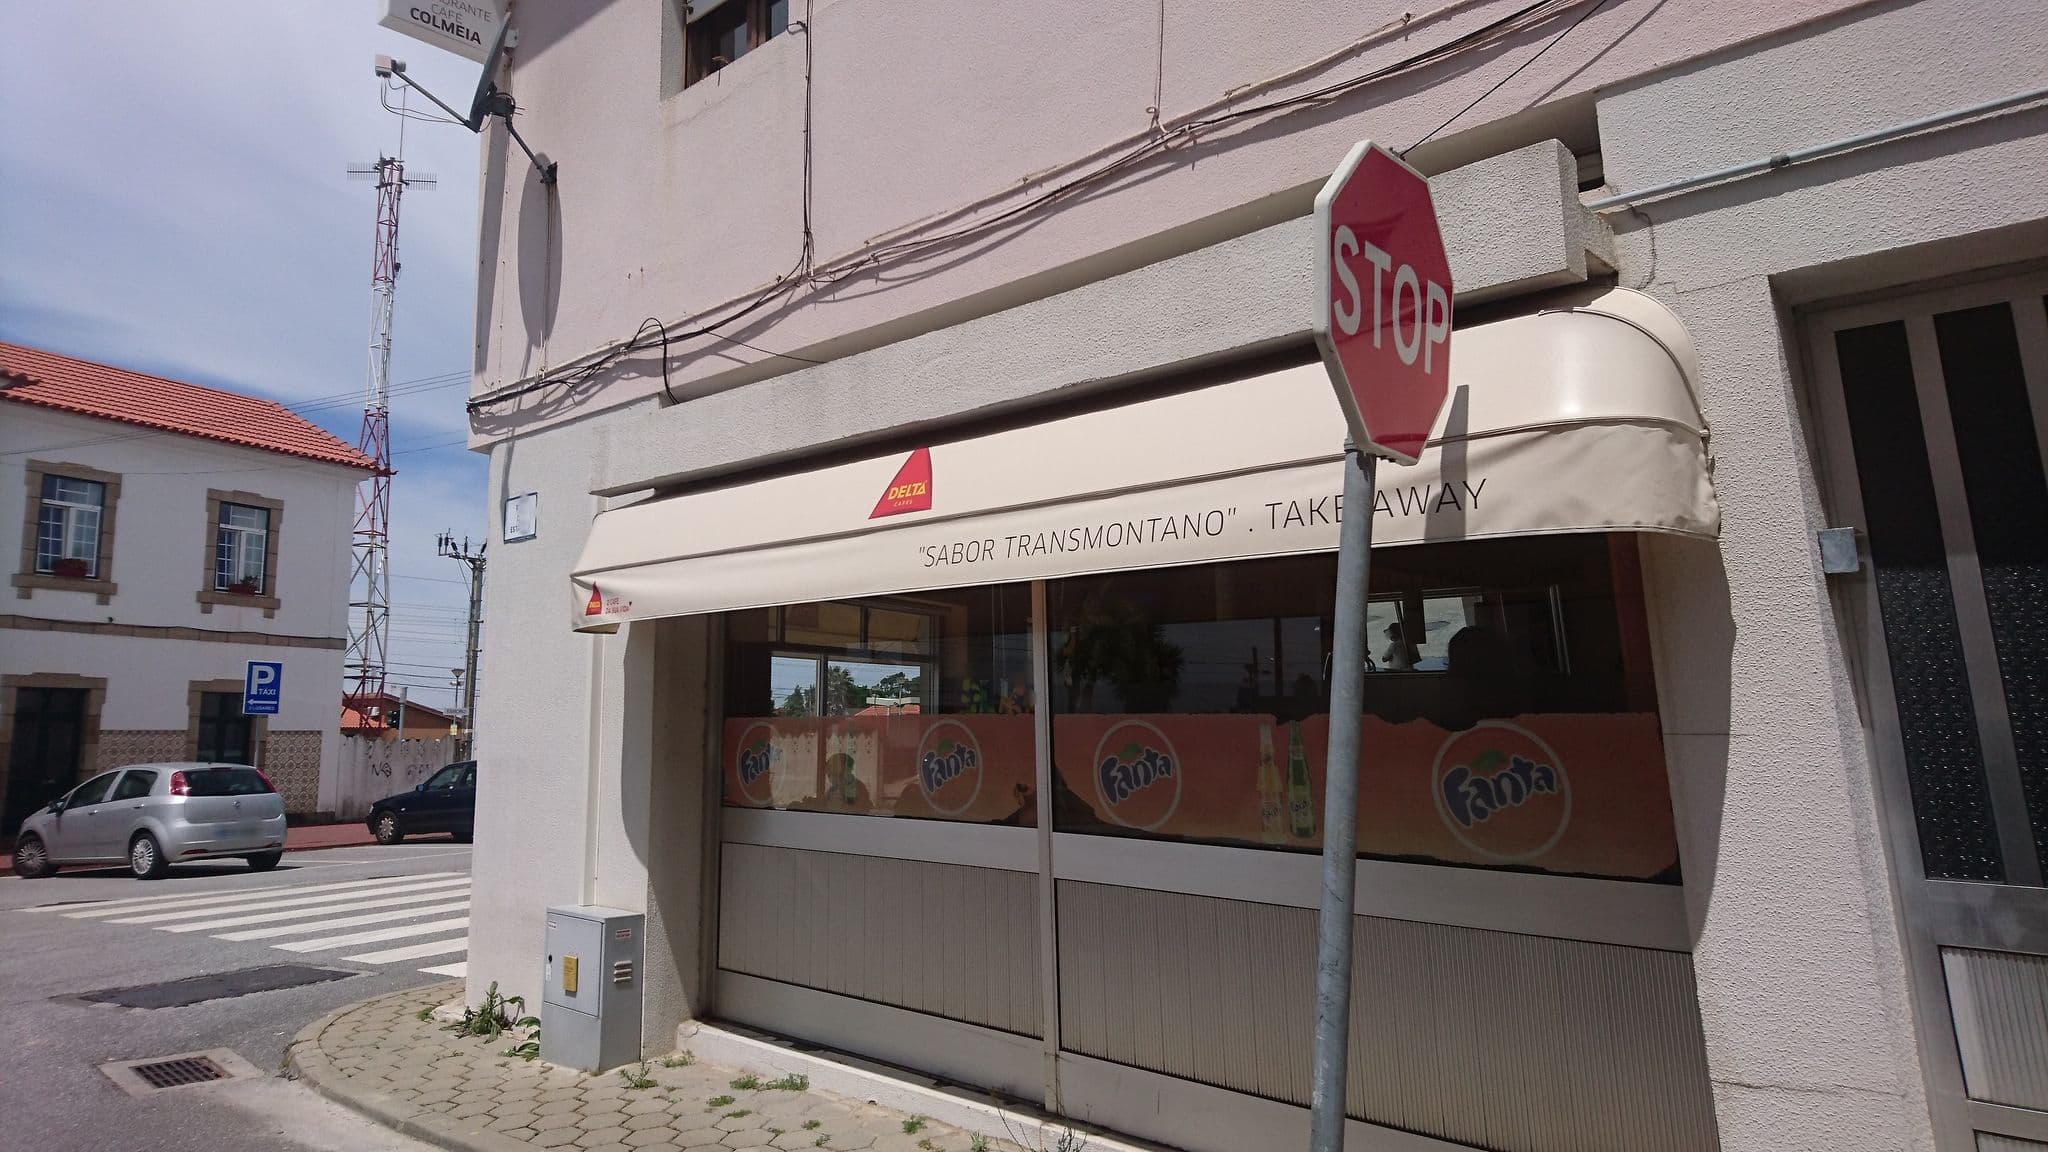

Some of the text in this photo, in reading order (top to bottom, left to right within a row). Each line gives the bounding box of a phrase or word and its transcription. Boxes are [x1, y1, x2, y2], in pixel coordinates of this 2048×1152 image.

[410, 7, 482, 45] COLMEIA
[1333, 224, 1449, 375] STOP
[887, 482, 926, 500] DELTA
[918, 538, 995, 568] "SABOR
[1004, 506, 1238, 559] TRANSMONTANO"
[1265, 494, 1345, 530] TAKE
[1373, 477, 1487, 518] AWAY
[250, 665, 275, 695] P
[921, 742, 977, 793] Fanta
[1100, 746, 1173, 805] Fanta
[1441, 755, 1557, 828] Fanta
